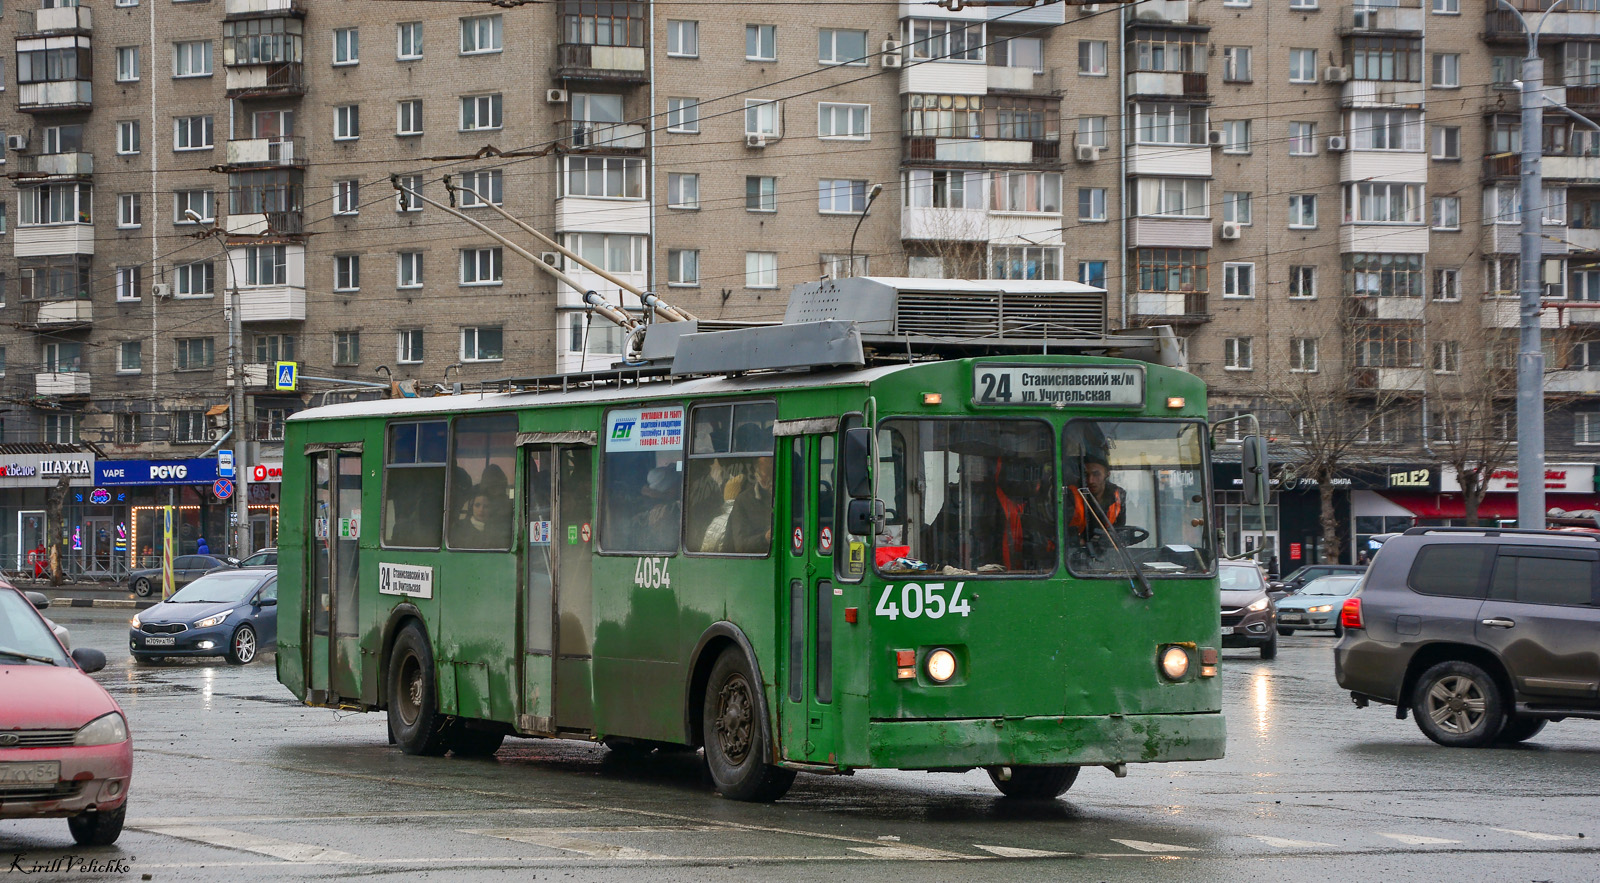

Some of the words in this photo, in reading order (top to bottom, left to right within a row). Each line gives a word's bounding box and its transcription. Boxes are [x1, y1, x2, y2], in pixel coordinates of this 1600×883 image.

[1022, 372, 1109, 386] Станиславский
[1111, 373, 1135, 386] ж/м
[981, 373, 1012, 402] 24
[1022, 390, 1038, 402] ул.
[1040, 389, 1111, 402] Учительская
[40, 460, 89, 474] ШАХТА
[103, 469, 124, 478] VAPE
[150, 465, 187, 479] PGVG
[1391, 469, 1430, 486] TELE2
[381, 566, 390, 590] 24
[635, 557, 670, 589] 4054
[875, 582, 971, 621] 4054
